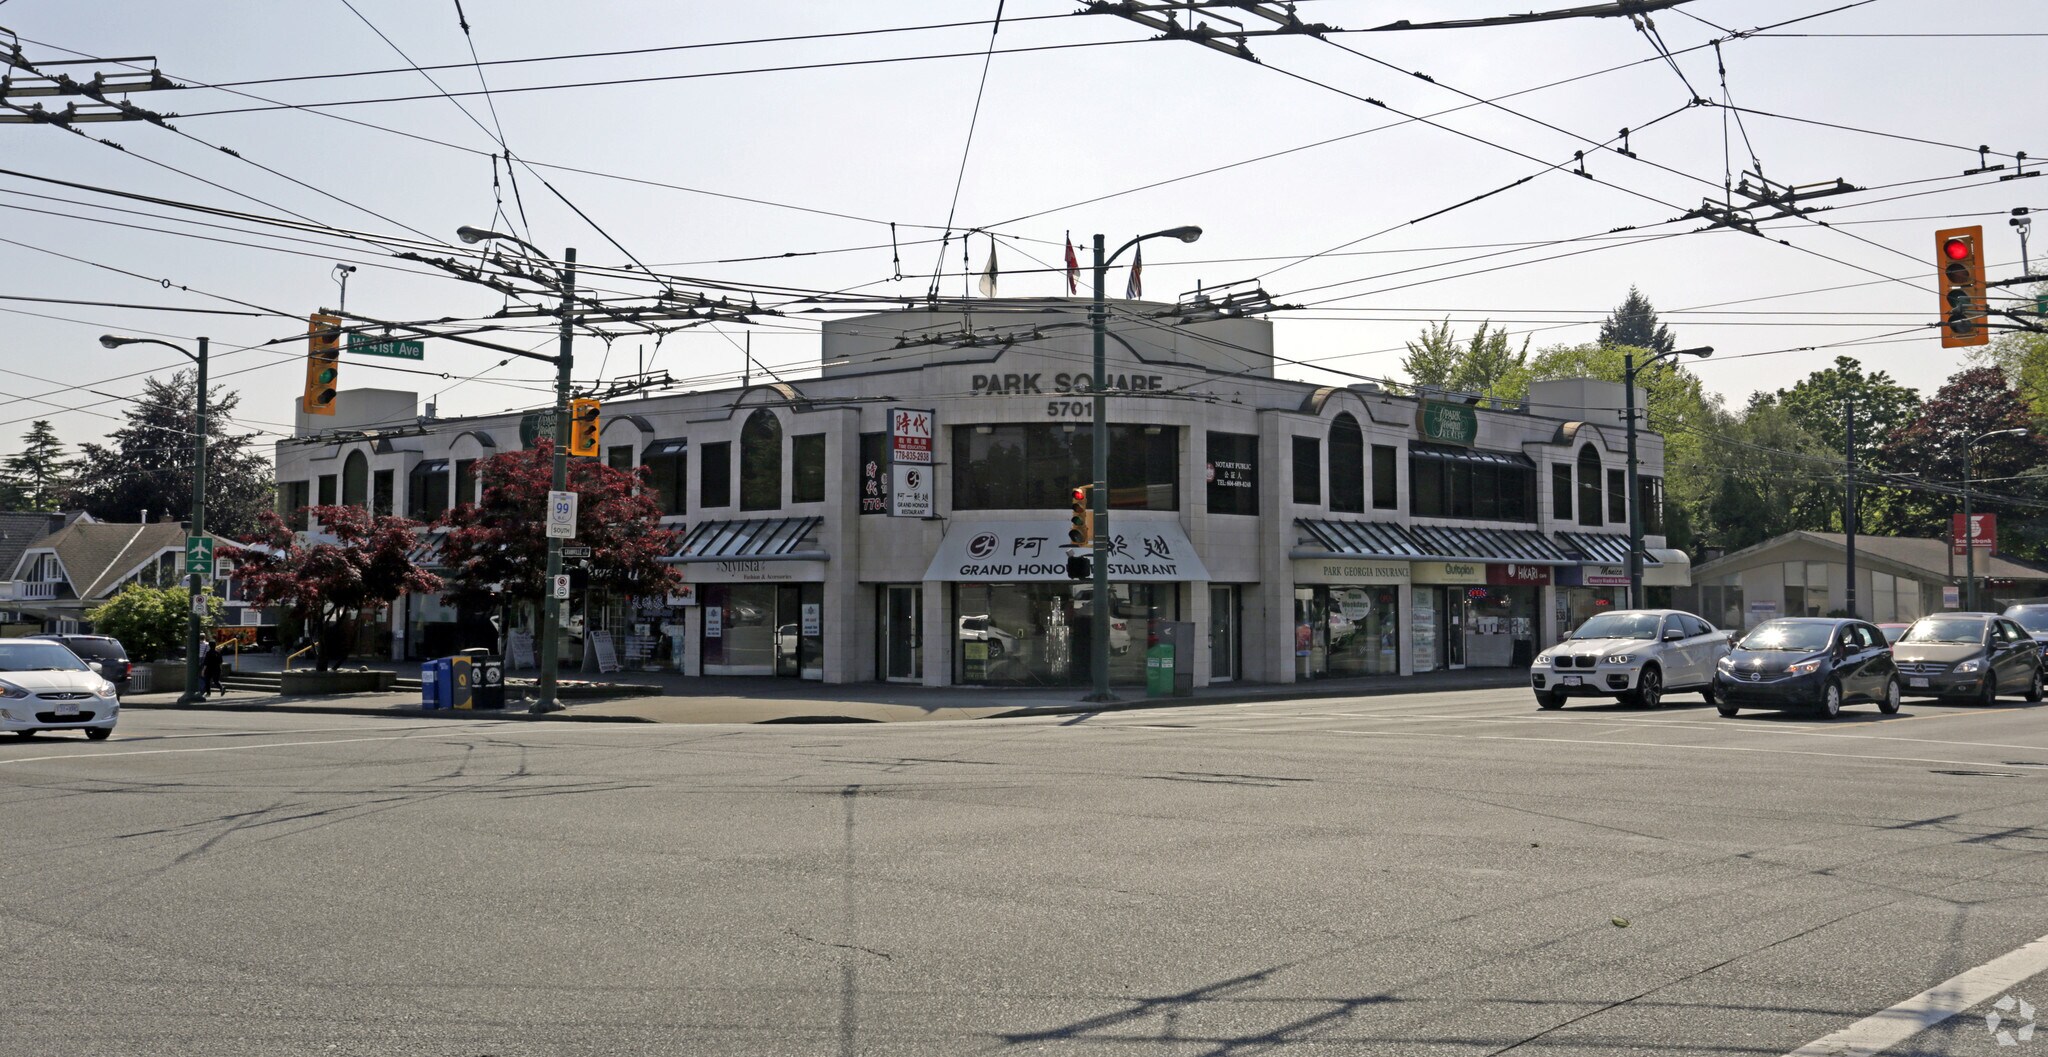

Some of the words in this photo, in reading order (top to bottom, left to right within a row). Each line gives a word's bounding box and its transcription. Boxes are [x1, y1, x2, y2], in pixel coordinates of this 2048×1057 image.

[369, 342, 394, 354] 41st
[399, 342, 420, 357] Ave
[972, 373, 1042, 396] PARK
[1047, 401, 1093, 417] 5701
[895, 412, 929, 436] 時代
[1215, 461, 1235, 469] NOTARY
[1235, 462, 1252, 470] PUBLIC
[556, 502, 569, 514] 99
[901, 508, 926, 516] RESTAURANT
[720, 560, 760, 577] Stylista
[959, 564, 1013, 575] GRAND
[1017, 564, 1070, 575] HONO
[1090, 564, 1178, 575] STAURANT
[1323, 566, 1342, 576] PARK
[1344, 567, 1374, 577] GEORGIA
[1375, 568, 1409, 577] INSURANCE
[1600, 566, 1623, 576] Monica
